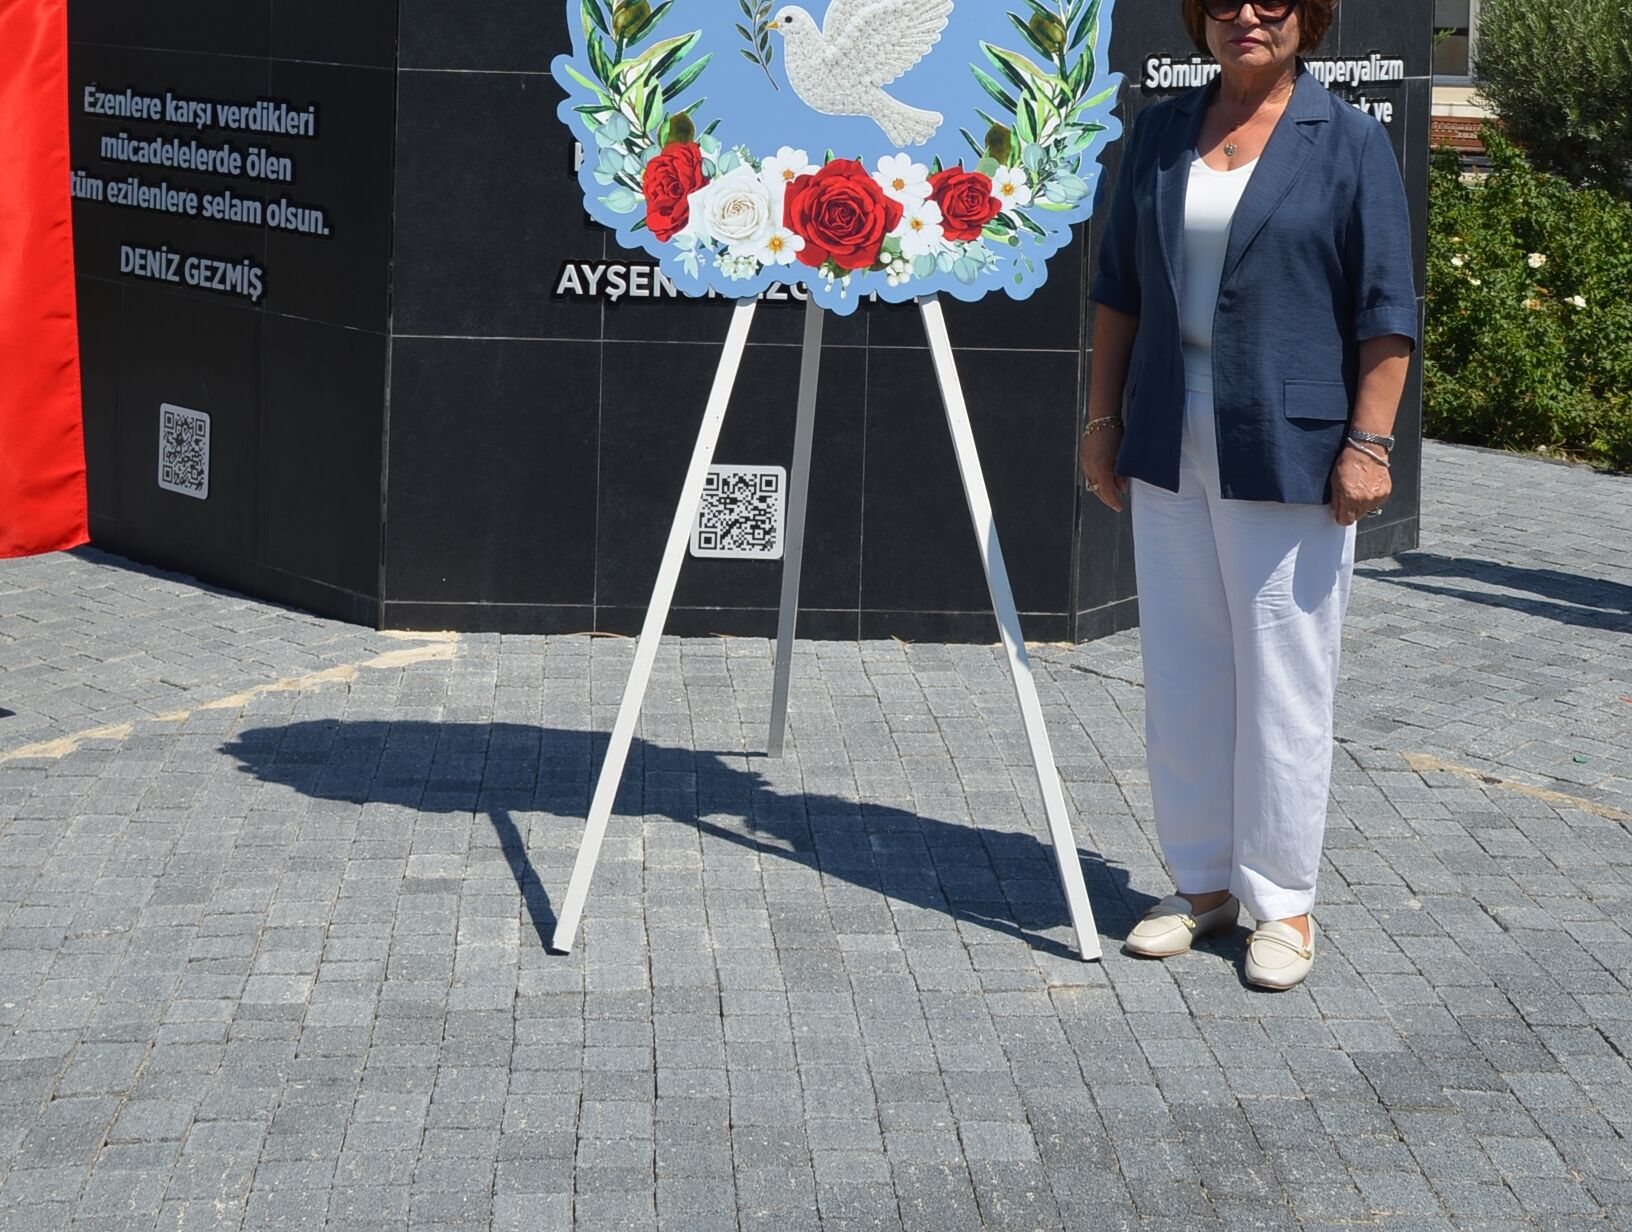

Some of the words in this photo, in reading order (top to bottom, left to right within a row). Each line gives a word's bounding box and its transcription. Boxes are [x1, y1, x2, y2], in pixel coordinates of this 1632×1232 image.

[1304, 53, 1404, 89] mperyalizm
[83, 86, 162, 119] Ezenlere
[165, 92, 212, 129] karşı
[216, 101, 316, 136] verdikleri
[1372, 101, 1393, 123] ve
[100, 132, 242, 175] mücadelelerde
[246, 148, 292, 182] ölen
[107, 177, 198, 215] ezilenlere
[202, 190, 262, 225] selam
[266, 198, 330, 235] olsun.
[120, 245, 180, 283] DENİZ
[184, 256, 263, 302] GEZMİŞ
[556, 263, 728, 302] AYŞEN
